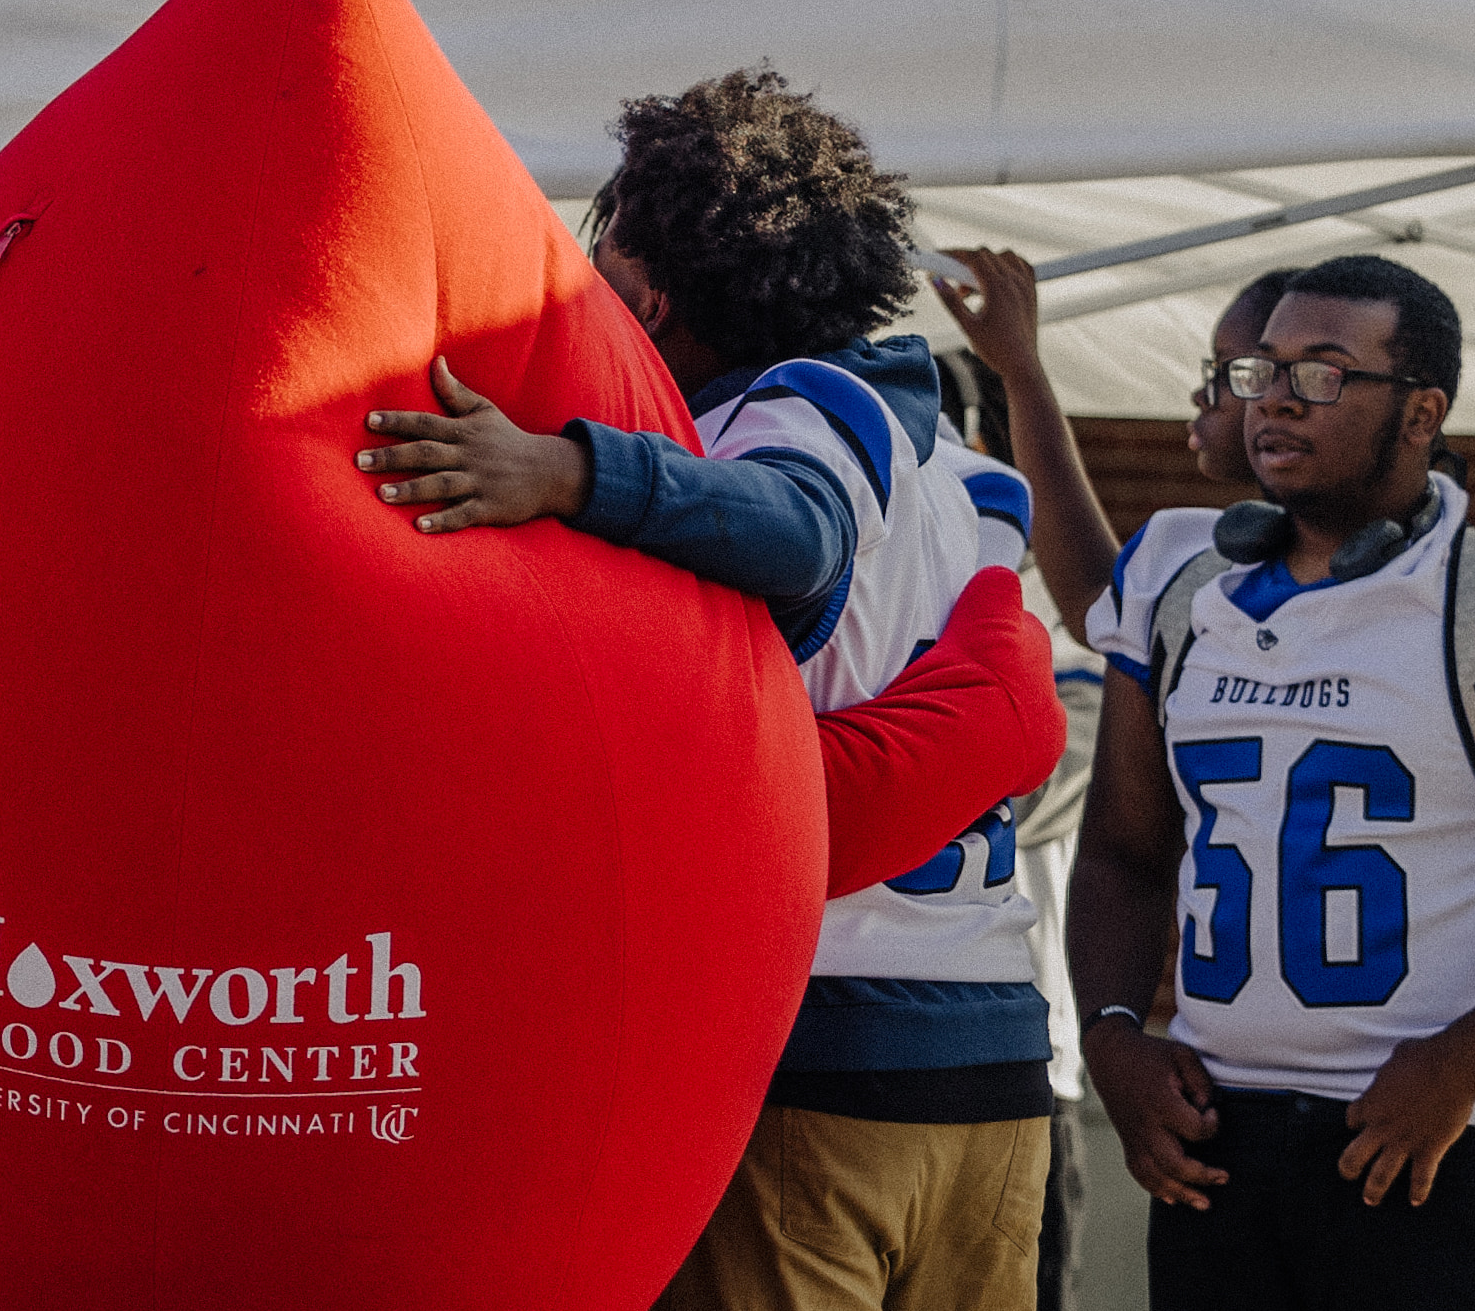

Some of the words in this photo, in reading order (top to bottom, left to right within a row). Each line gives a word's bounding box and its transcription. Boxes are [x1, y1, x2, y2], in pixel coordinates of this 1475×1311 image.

[1209, 675, 1351, 709] BULLDOGS
[1172, 735, 1415, 1008] 56
[173, 1042, 420, 1083] CENTER
[107, 1107, 146, 1131] OF
[163, 1112, 354, 1136] CINCINNATI
